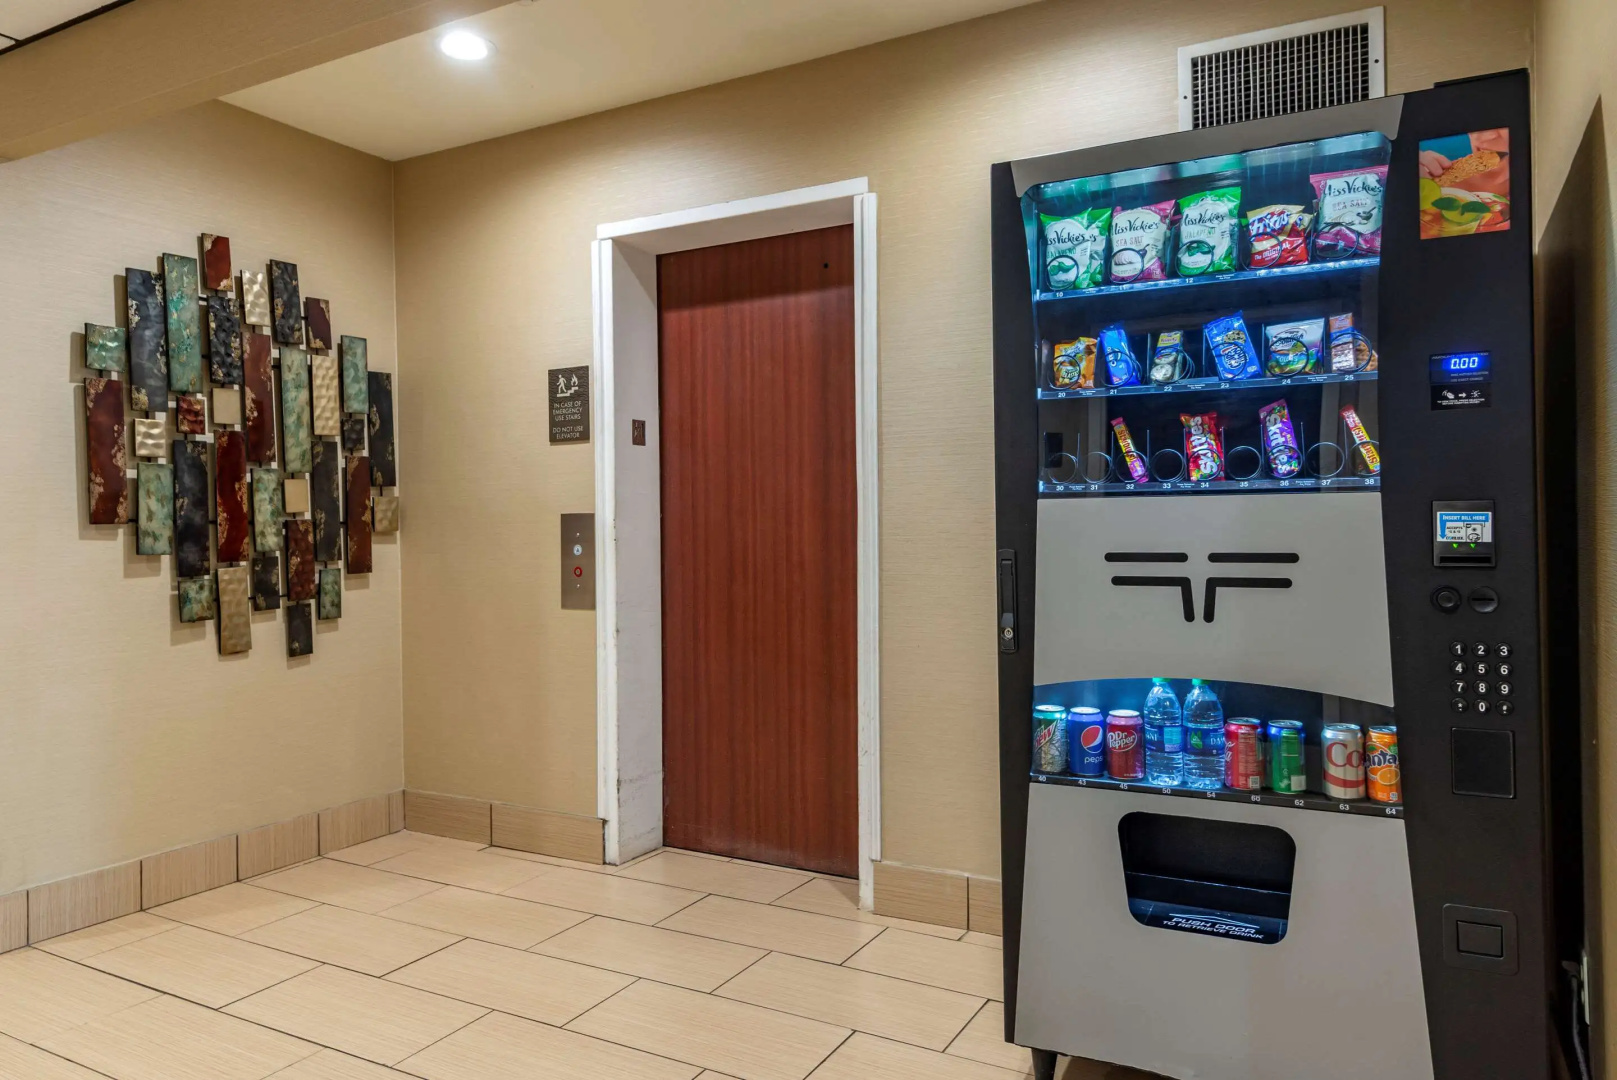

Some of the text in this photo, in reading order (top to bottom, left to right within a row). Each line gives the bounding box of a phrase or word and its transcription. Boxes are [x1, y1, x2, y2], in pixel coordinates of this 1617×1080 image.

[1184, 213, 1198, 226] iss
[1127, 216, 1159, 233] Vickie's
[1450, 357, 1478, 369] 0.00
[1456, 645, 1460, 654] 1
[1478, 646, 1484, 654] 2
[1501, 646, 1507, 655] 3
[1456, 663, 1462, 672] 4
[1479, 664, 1485, 673] 5
[1501, 665, 1508, 674] 6
[1457, 683, 1463, 691] 7
[1479, 683, 1485, 692] 8
[1501, 685, 1508, 694] 9
[1479, 702, 1485, 711] 0
[1116, 731, 1128, 740] Dr
[1108, 732, 1135, 749] Pepper
[1326, 742, 1363, 768] Co
[1084, 756, 1103, 764] peps
[1172, 917, 1256, 934] PUSH DOOR
[1178, 923, 1227, 934] RETRIEVE
[1229, 930, 1264, 939] DRINK
